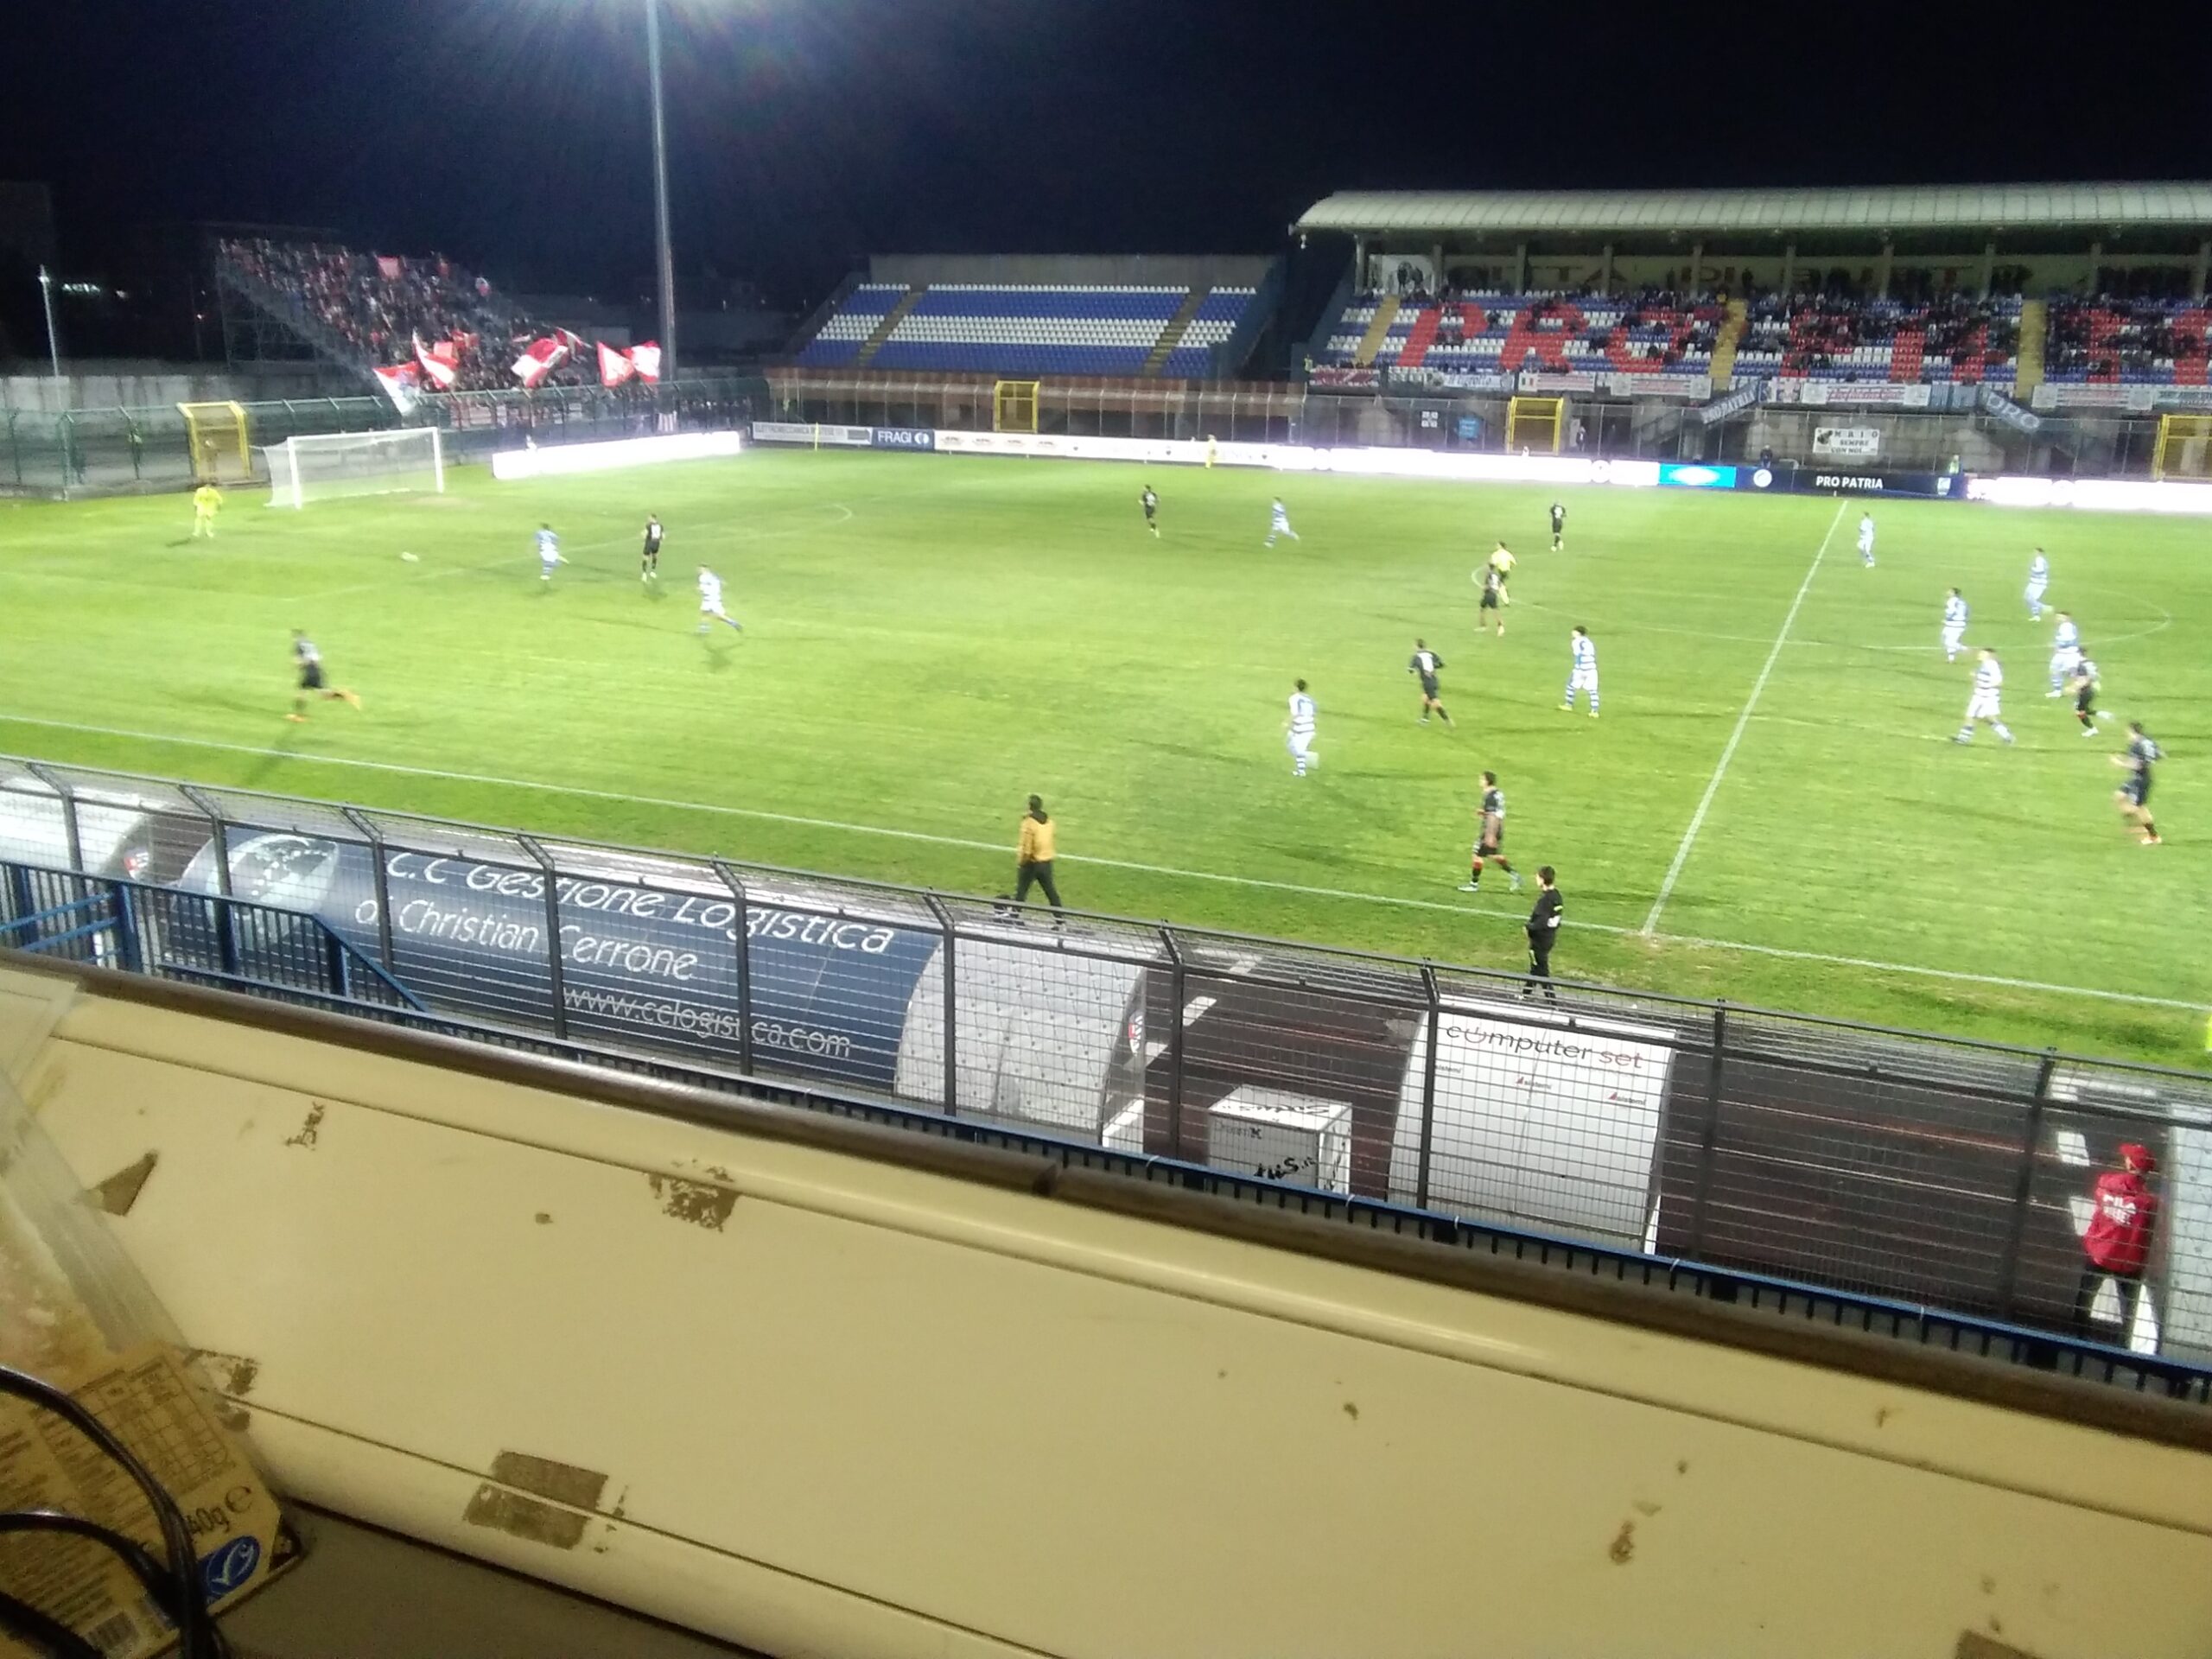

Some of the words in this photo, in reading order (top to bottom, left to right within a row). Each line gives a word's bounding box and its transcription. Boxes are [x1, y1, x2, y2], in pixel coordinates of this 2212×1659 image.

[877, 430, 912, 444] FRAGI
[1815, 476, 1840, 488] PRO
[1841, 477, 1884, 489] PATRIA
[466, 864, 665, 918] Gestione
[399, 899, 539, 952] Christian
[563, 987, 851, 1058] www.cclogistca.com
[1599, 1051, 1643, 1070] set
